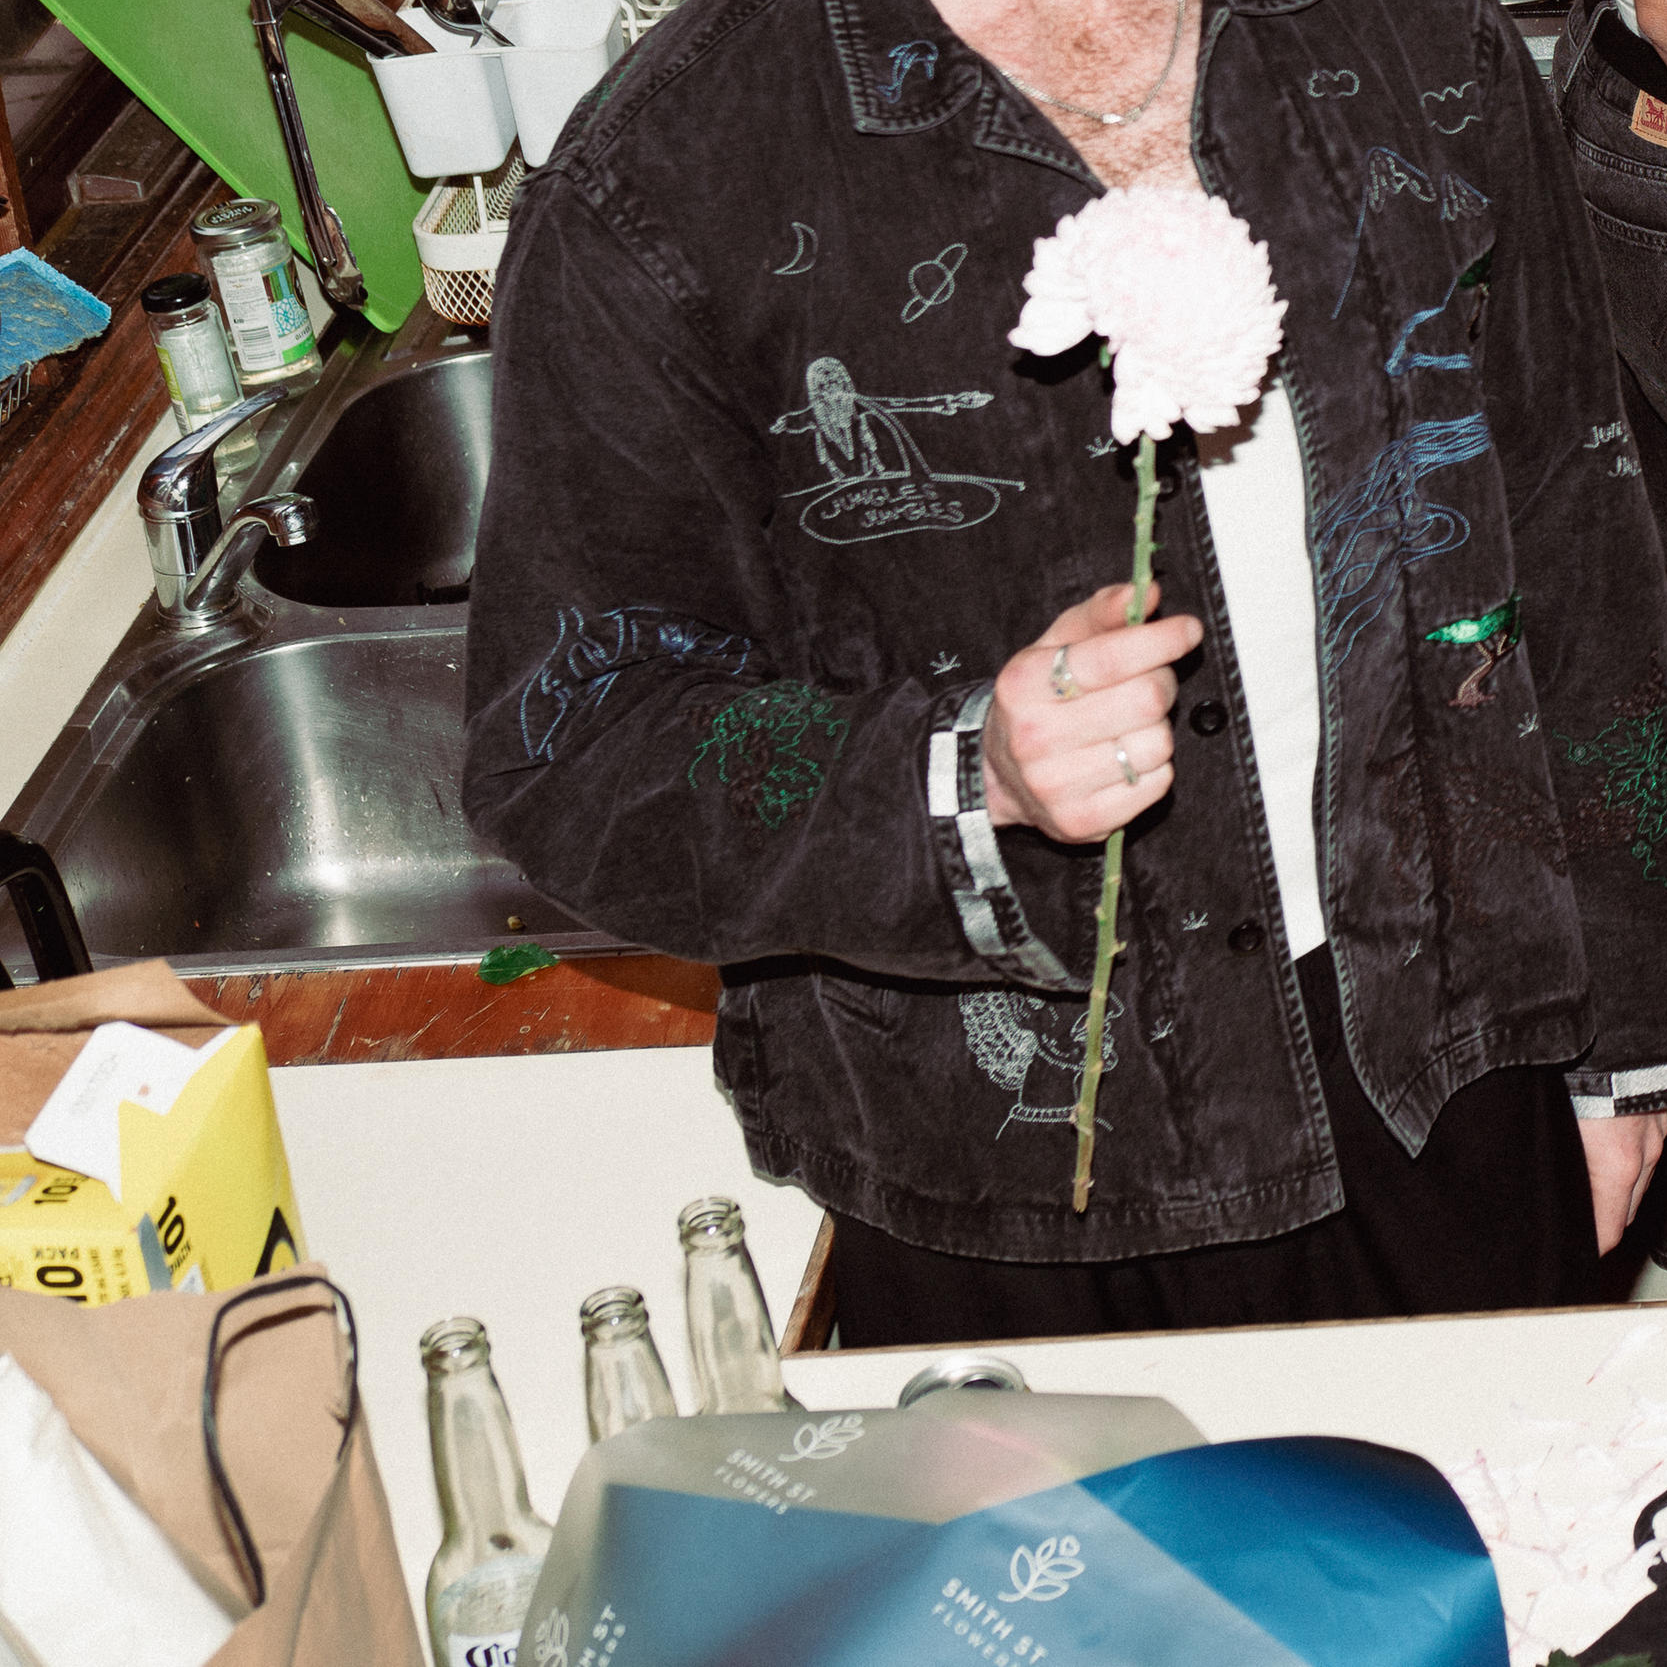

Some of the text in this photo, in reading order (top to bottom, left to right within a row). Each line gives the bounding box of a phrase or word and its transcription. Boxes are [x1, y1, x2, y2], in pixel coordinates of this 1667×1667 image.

[713, 1465, 789, 1516] FLOWERS
[726, 1448, 818, 1503] SMITH ST
[941, 1577, 1049, 1666] SMITH ST
